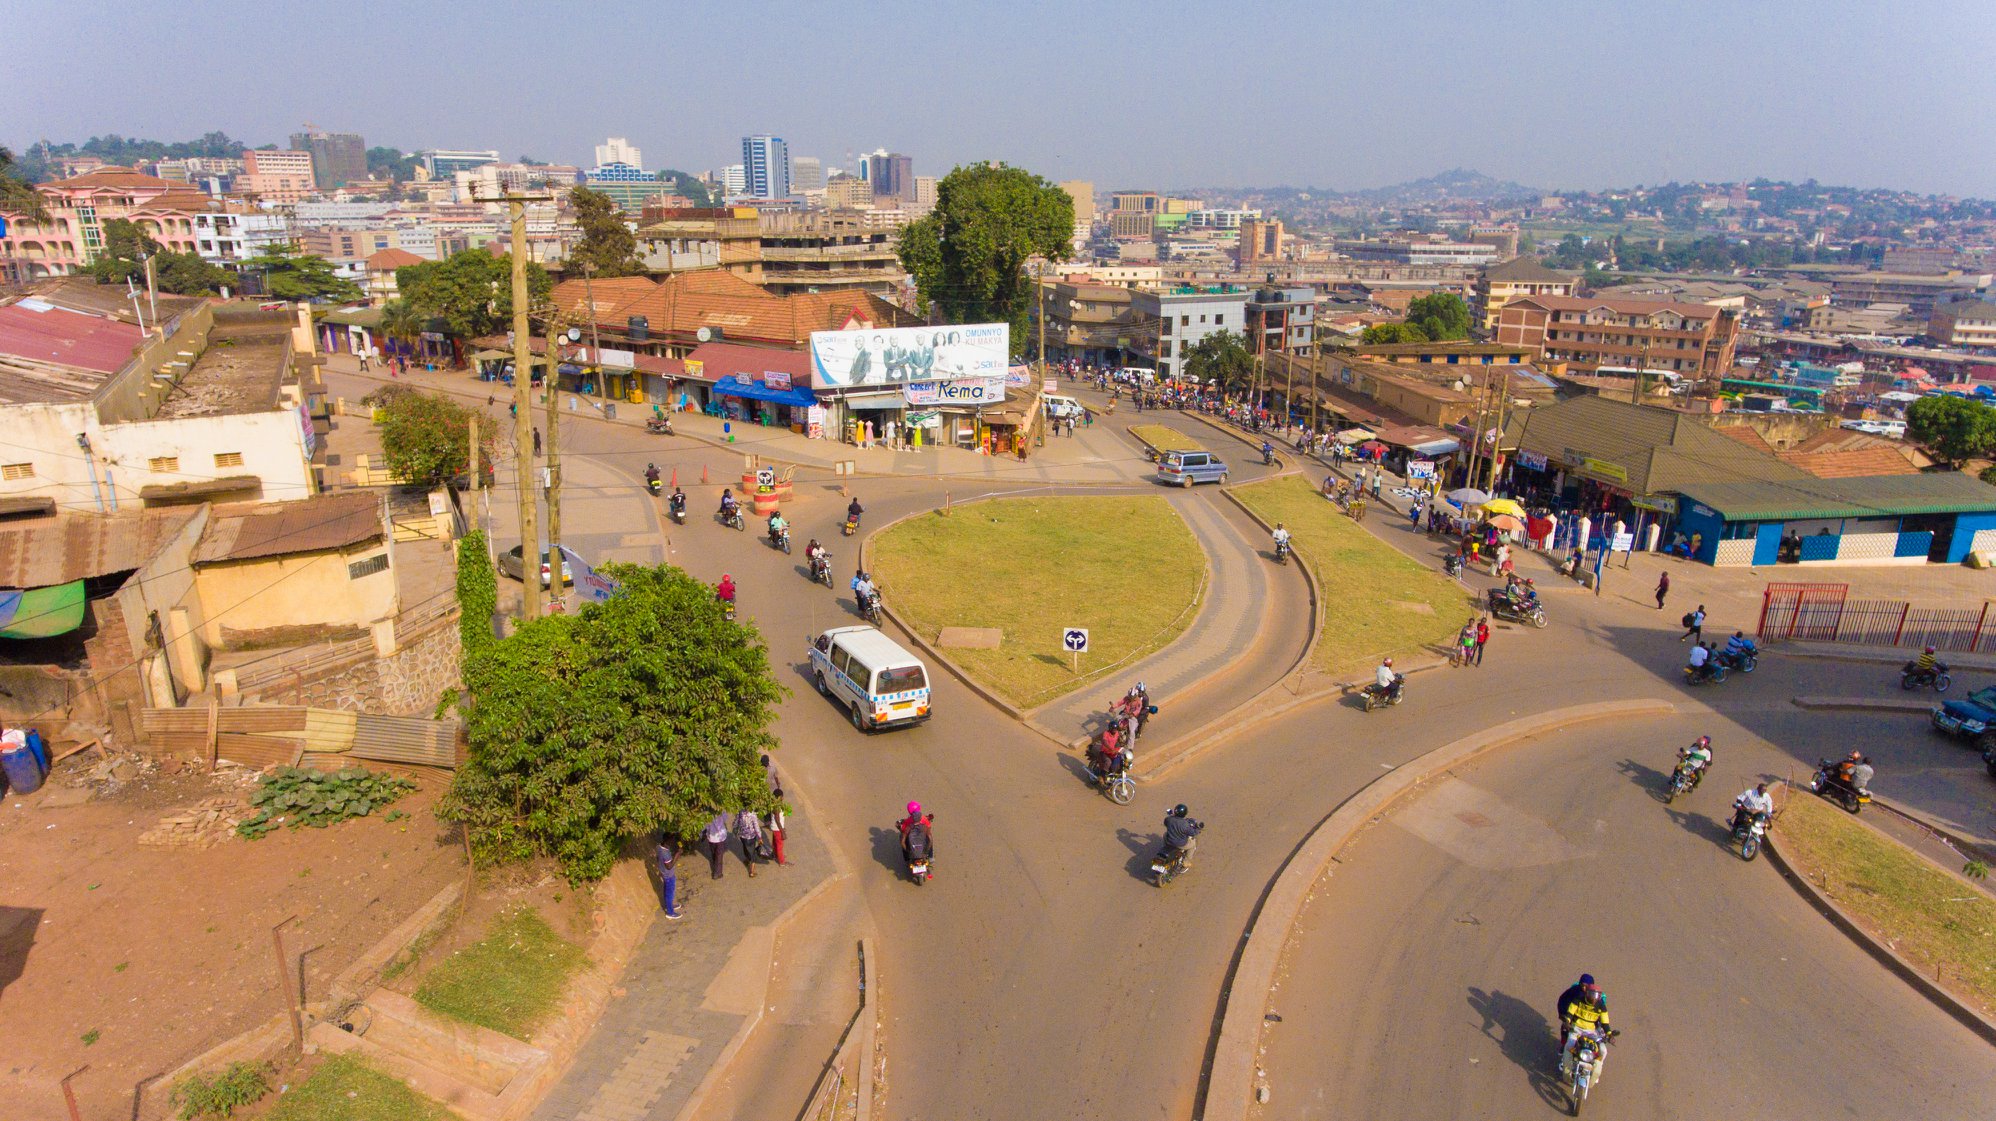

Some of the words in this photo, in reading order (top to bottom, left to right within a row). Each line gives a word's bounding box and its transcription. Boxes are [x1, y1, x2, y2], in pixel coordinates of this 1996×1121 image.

[966, 328, 1003, 337] OMUNNYO
[966, 337, 976, 345] KU
[978, 336, 1003, 345] MAKYA
